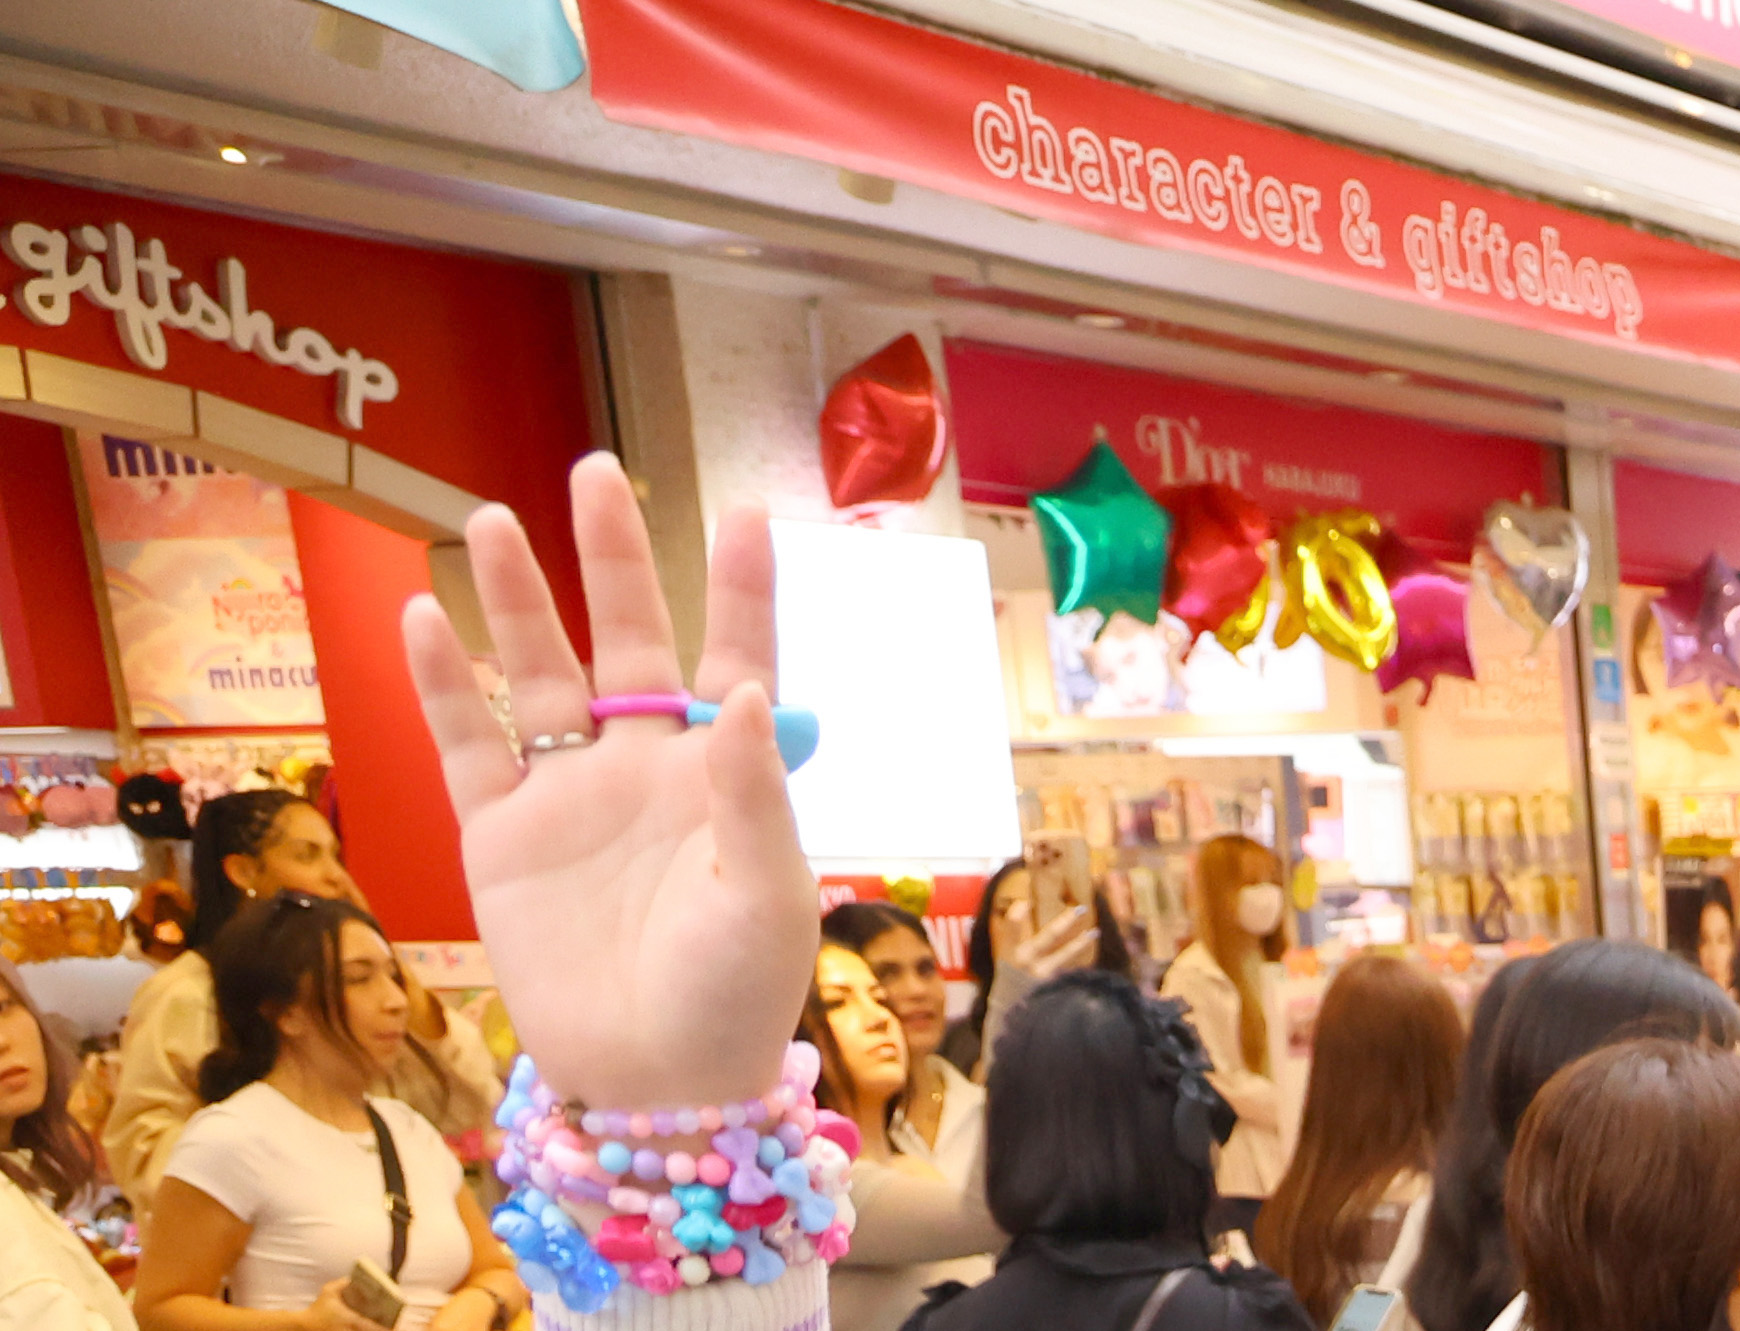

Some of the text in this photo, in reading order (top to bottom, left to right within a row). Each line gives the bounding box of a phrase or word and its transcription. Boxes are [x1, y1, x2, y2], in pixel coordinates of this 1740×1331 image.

[7, 222, 400, 430] giftshop
[973, 86, 1644, 340] character & giftshop
